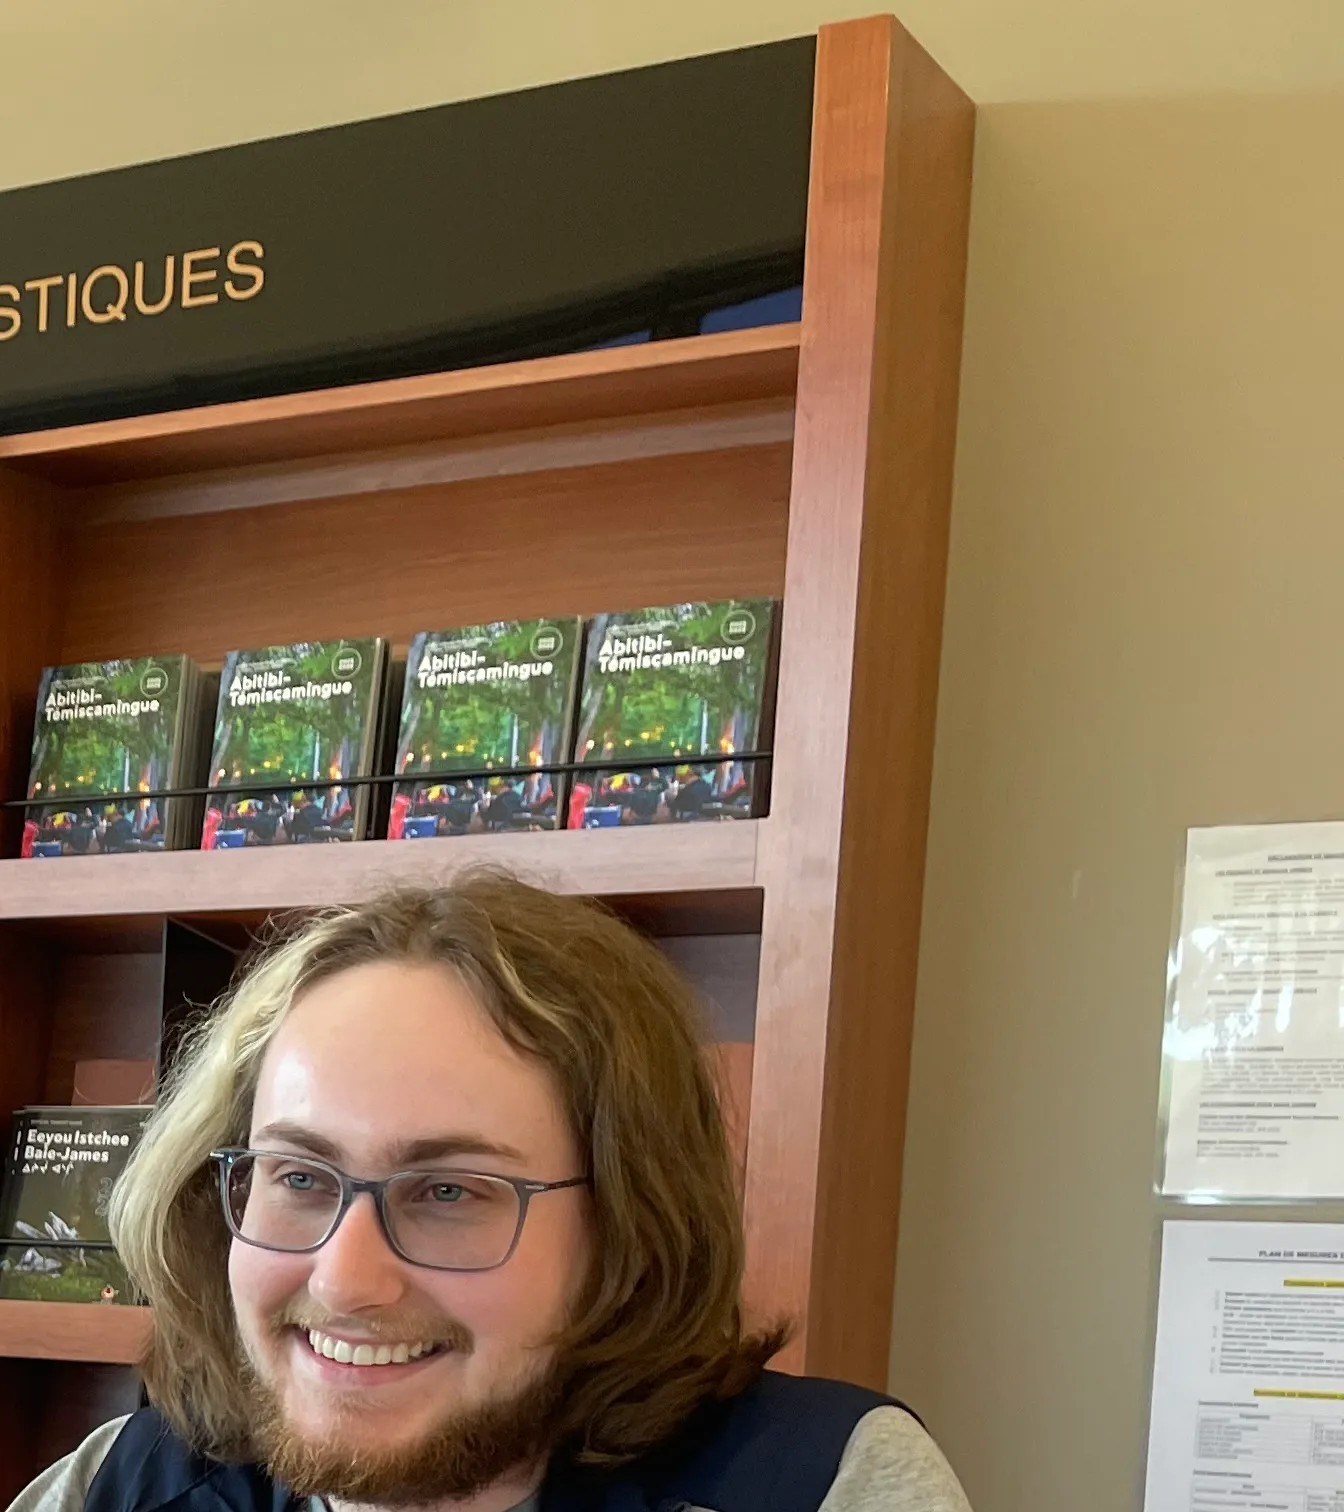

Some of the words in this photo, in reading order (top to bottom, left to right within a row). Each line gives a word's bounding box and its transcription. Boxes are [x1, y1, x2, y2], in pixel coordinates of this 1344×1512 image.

[599, 635, 673, 656] Abitibi-
[418, 652, 486, 673] Abitibi-
[598, 646, 745, 673] Témiscamingue
[230, 672, 291, 691] Abitibi-
[418, 661, 553, 688] Témiscamingue
[45, 688, 102, 708] Abitibi-
[230, 682, 352, 707] Témiscamingue
[45, 699, 159, 722] Témiscamingue
[27, 1129, 72, 1146] Eeyou
[75, 1130, 129, 1147] Istchee
[24, 1145, 109, 1163] Baie-James
